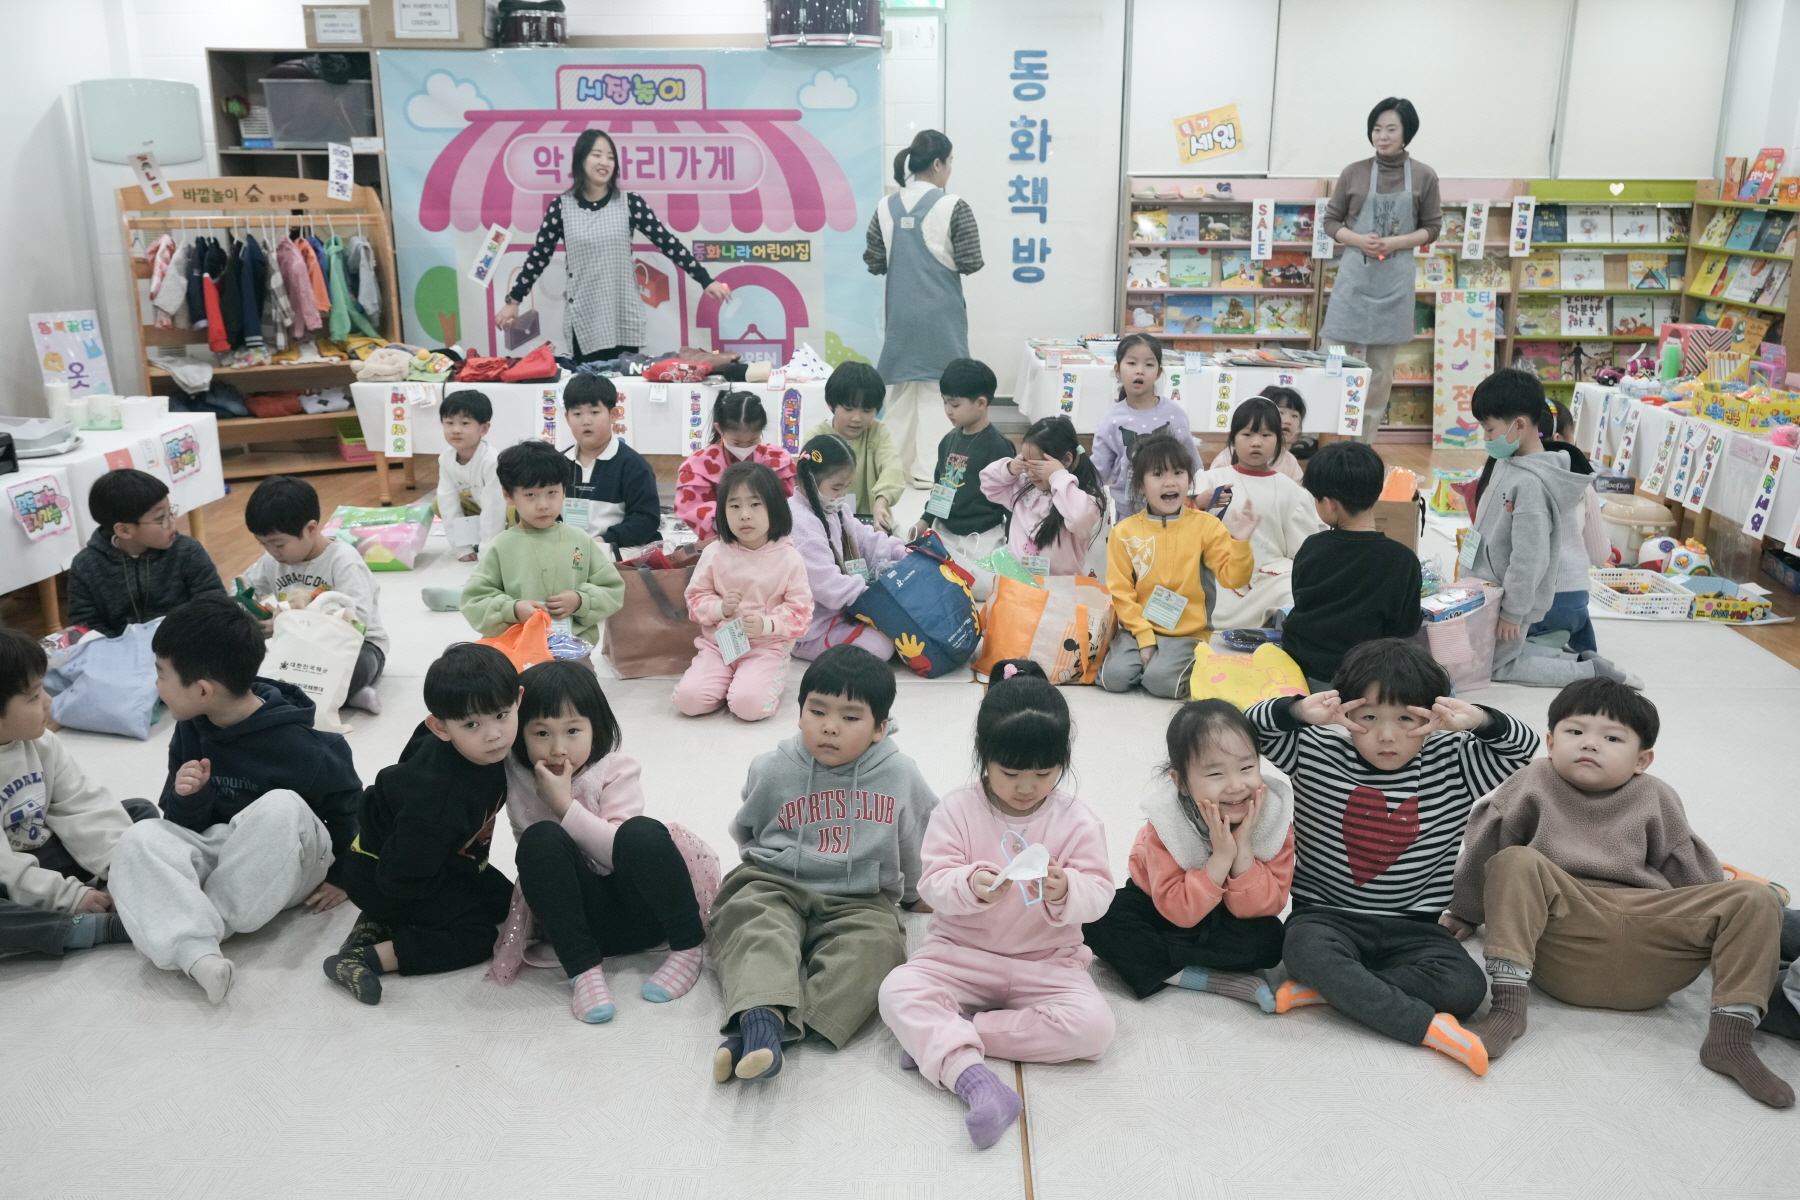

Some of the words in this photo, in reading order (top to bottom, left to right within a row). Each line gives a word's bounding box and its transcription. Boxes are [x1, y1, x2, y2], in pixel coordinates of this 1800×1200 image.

[577, 73, 686, 105] 시장놀이
[1189, 123, 1237, 157] 세일
[1008, 49, 1053, 284] 동화책방
[182, 188, 239, 203] 바깥놀이
[1256, 203, 1269, 256] SALE
[1514, 202, 1532, 252] 재고정리
[1440, 290, 1491, 304] 행복장터
[67, 361, 90, 390] 옷
[390, 392, 408, 453] 싸요싸요
[1216, 372, 1233, 428] 싸요싸요
[1345, 375, 1365, 432] 90%파격
[777, 789, 847, 831] SPORTS
[850, 789, 896, 825] CLUB
